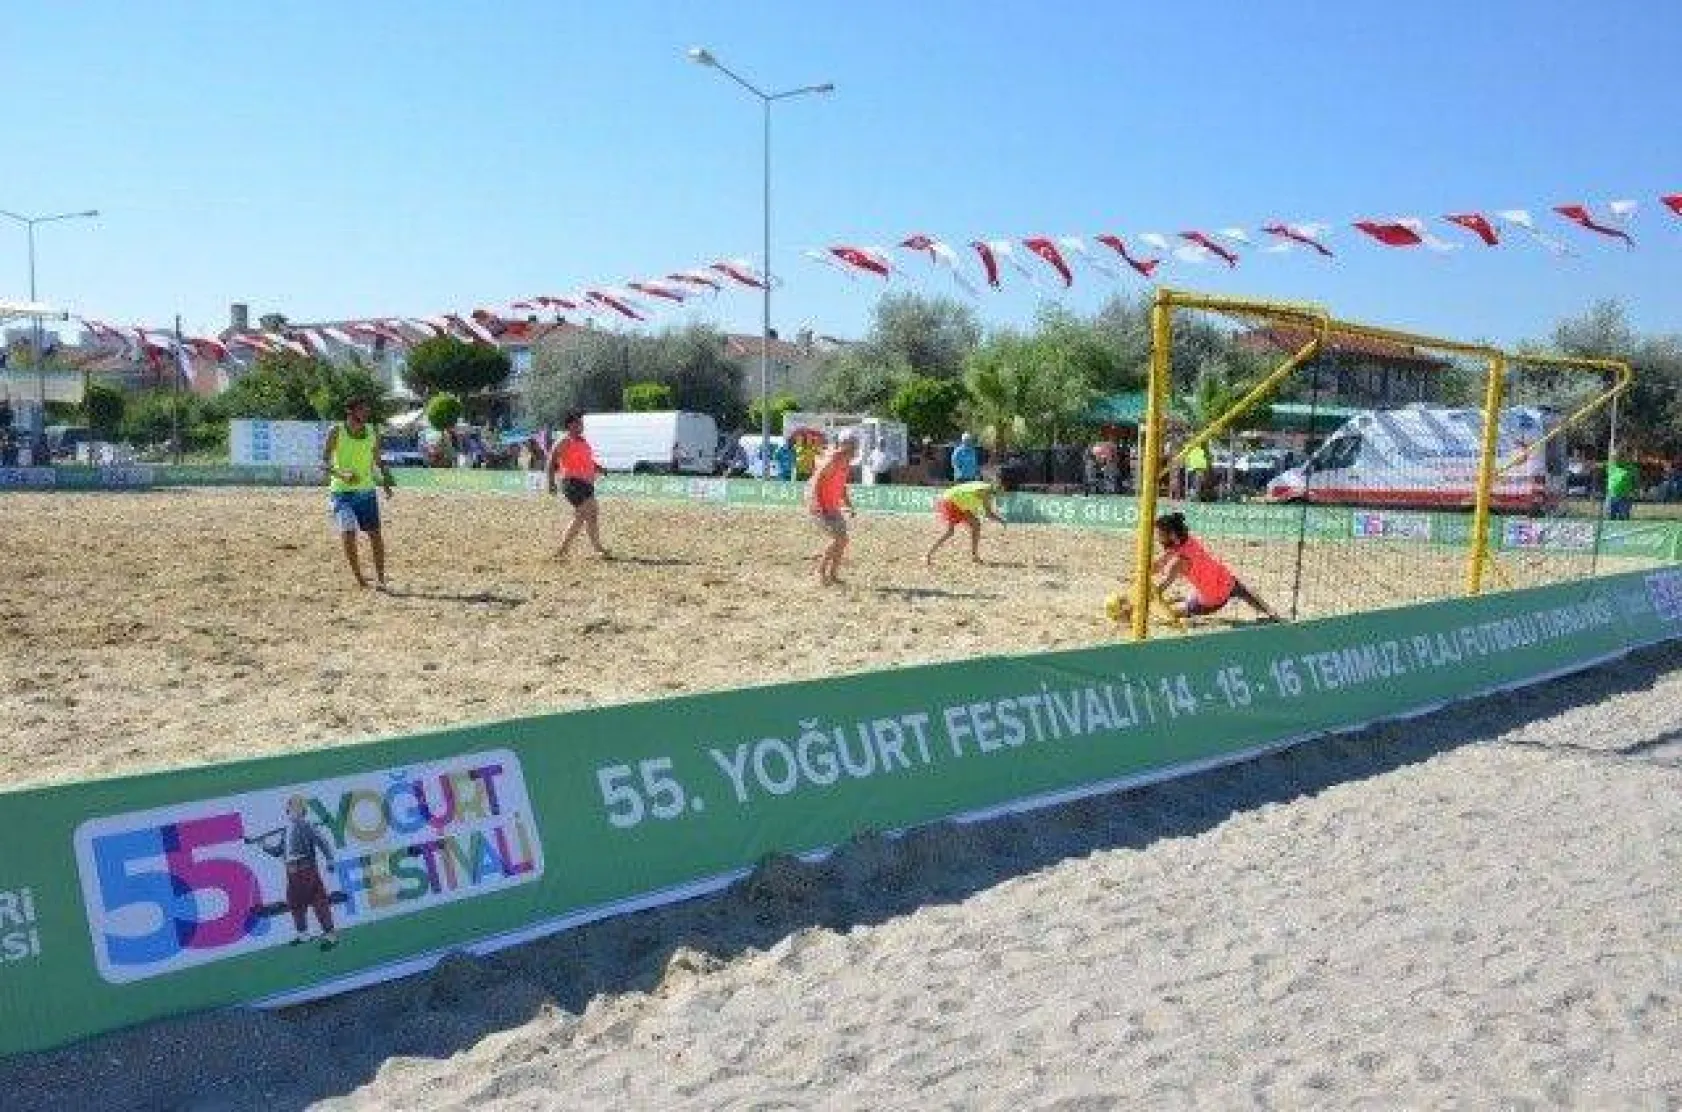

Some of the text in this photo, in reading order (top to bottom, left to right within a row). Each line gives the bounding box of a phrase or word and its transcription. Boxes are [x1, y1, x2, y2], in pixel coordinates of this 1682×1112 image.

[306, 764, 503, 848] YOĞURT
[596, 757, 705, 829] 55.
[711, 711, 934, 804] YOĞURT
[944, 673, 1138, 757] FESTİVALİ
[1161, 674, 1197, 719] 14
[1216, 664, 1252, 708] 15
[1270, 658, 1302, 698] 16
[1303, 640, 1406, 690] TEMMUZ
[91, 811, 261, 966] 55
